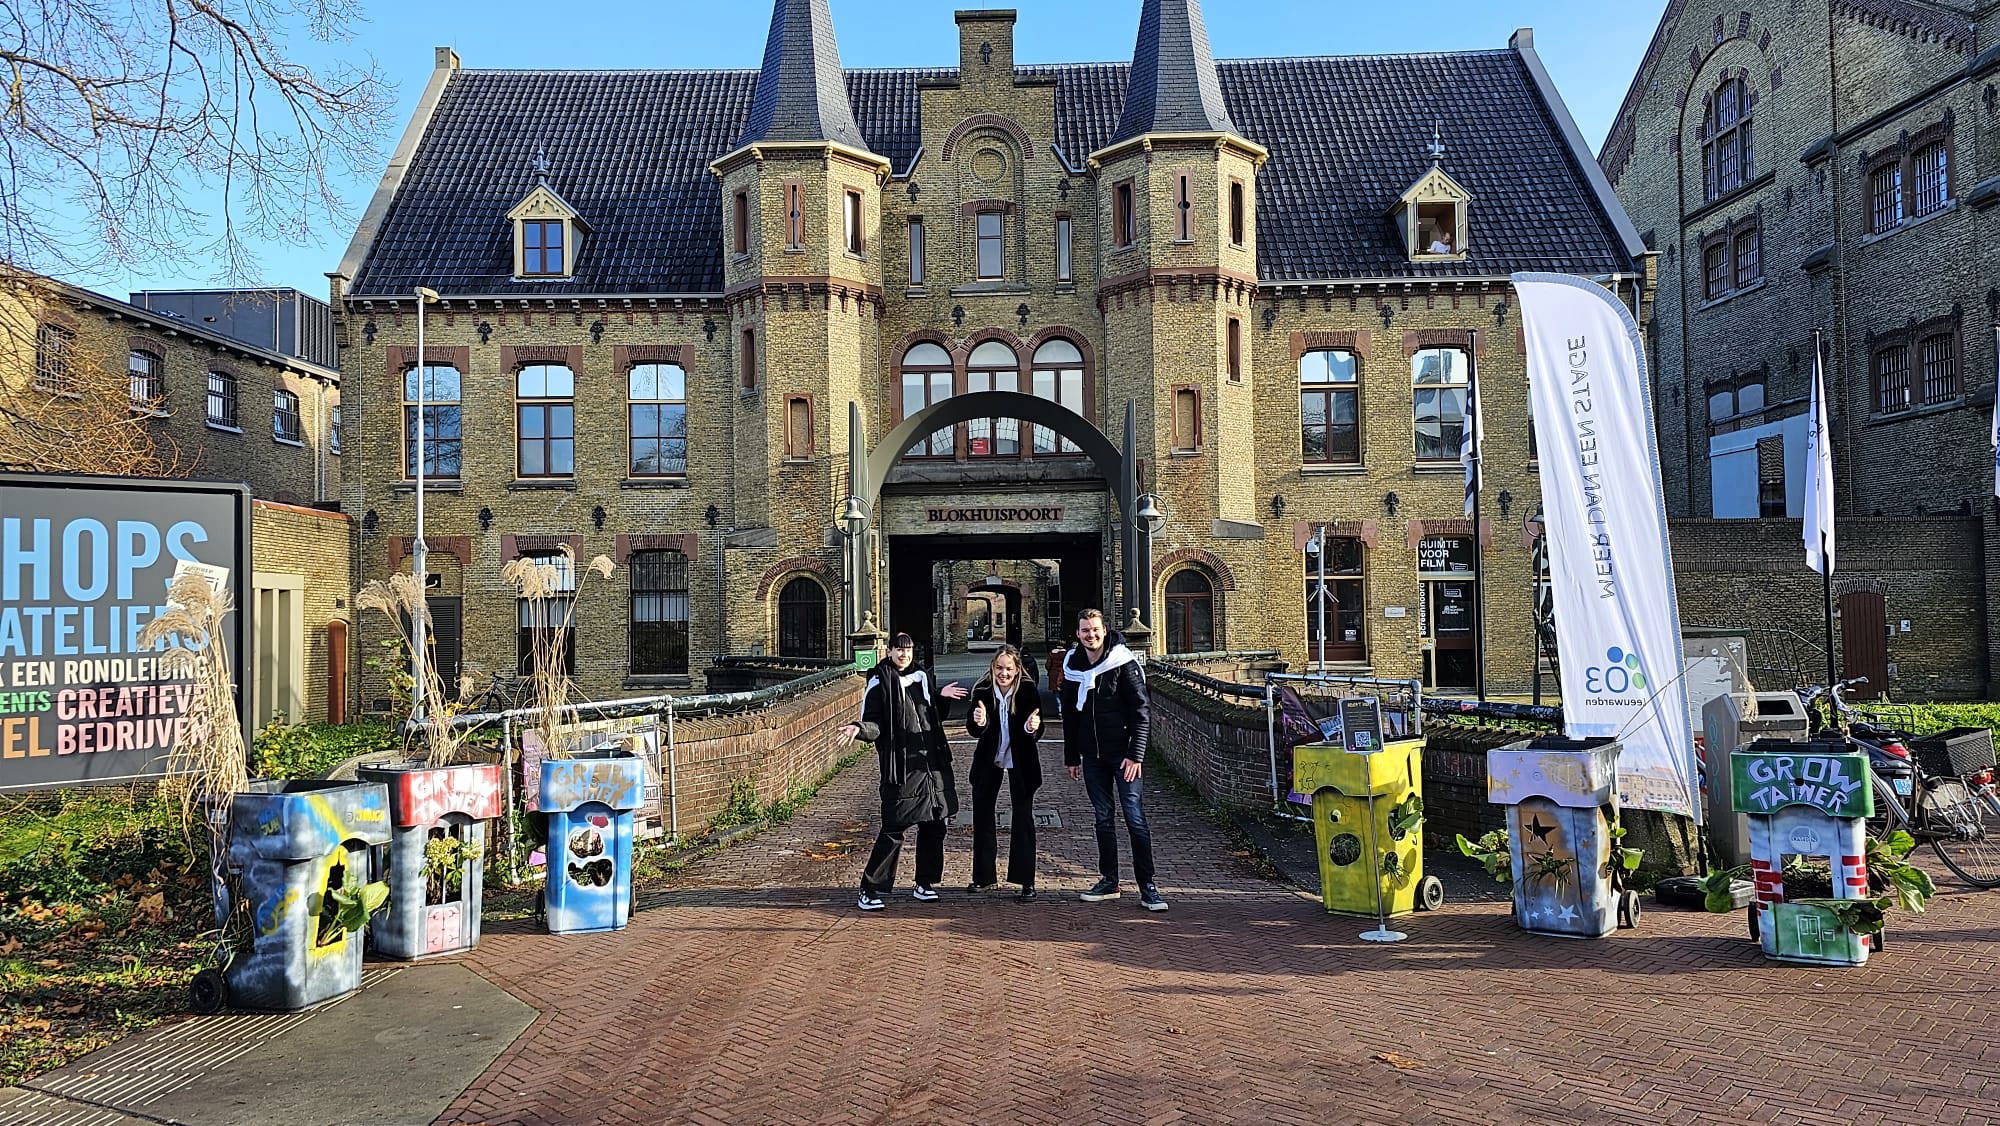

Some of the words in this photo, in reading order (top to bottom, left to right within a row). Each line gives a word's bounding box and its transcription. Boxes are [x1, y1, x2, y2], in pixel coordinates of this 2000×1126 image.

[927, 508, 1061, 521] BLOKHUISPOORT
[1420, 540, 1460, 549] RUIMTE
[1420, 550, 1449, 558] VOOR
[1420, 559, 1446, 568] FILM
[12, 661, 55, 687] EEN
[1748, 757, 1861, 793] GROW
